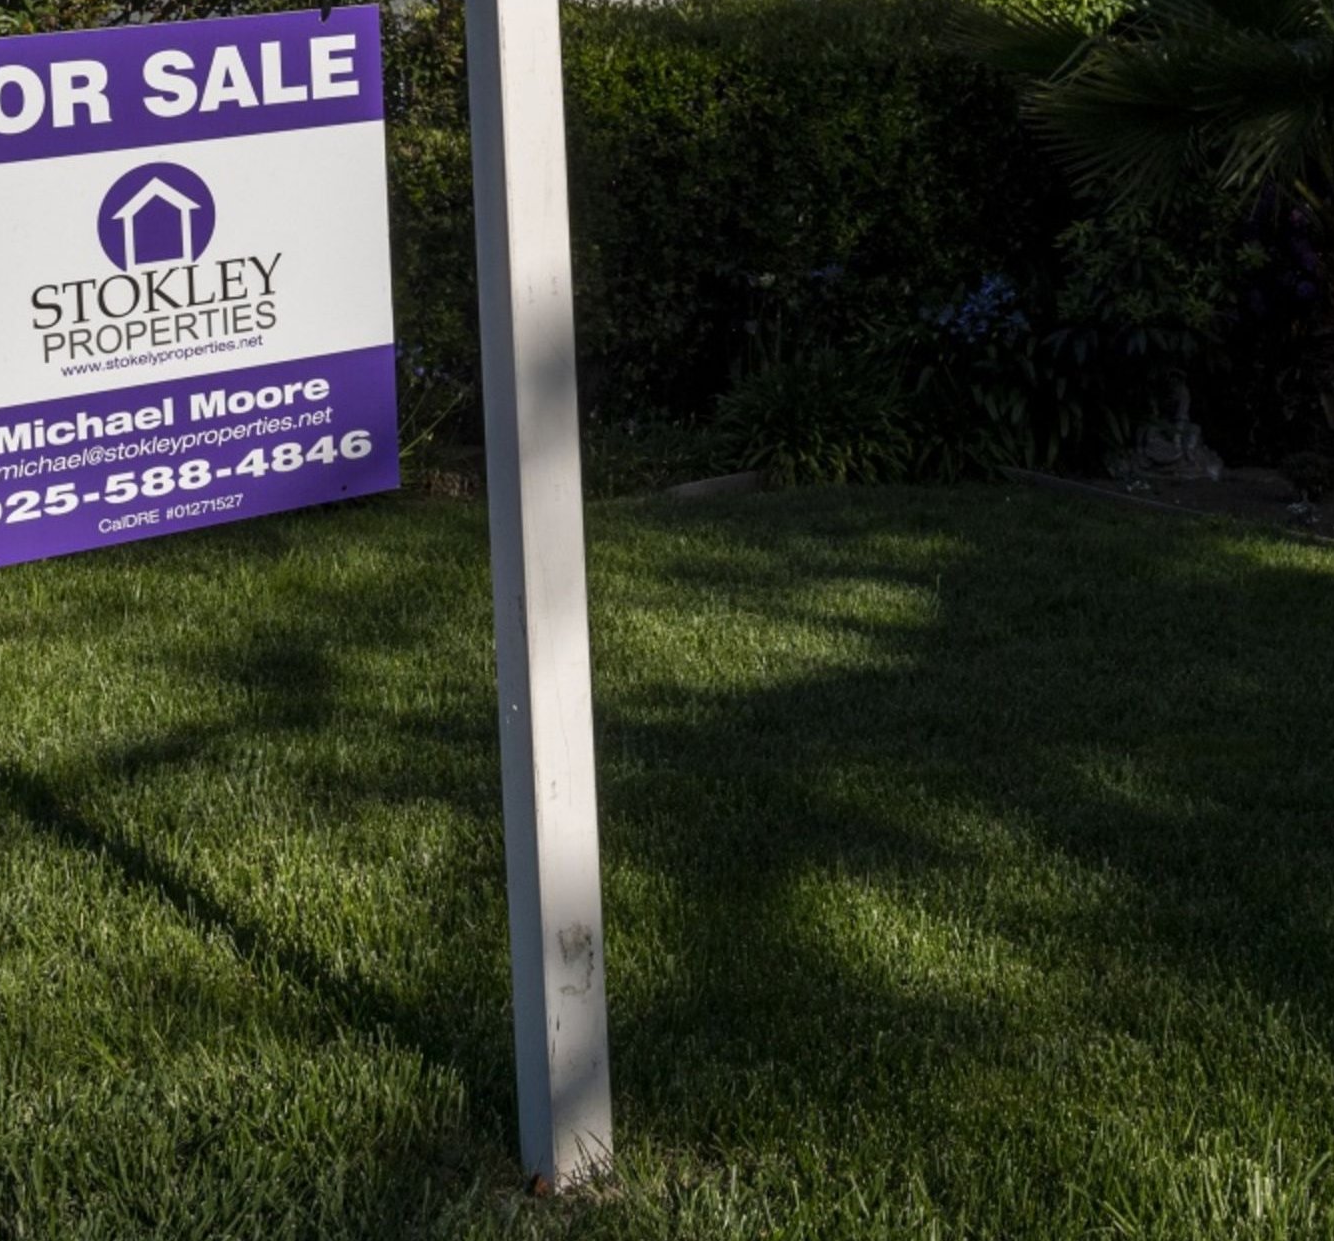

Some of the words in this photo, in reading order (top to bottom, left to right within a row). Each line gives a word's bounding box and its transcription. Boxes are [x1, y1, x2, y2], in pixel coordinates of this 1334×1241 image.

[143, 34, 359, 117] SALE
[30, 252, 282, 331] STOKLEY
[42, 300, 278, 364] PROPERTIES
[190, 377, 331, 422] Moore
[98, 509, 161, 534] CalDRE
[166, 493, 244, 520] #01271527
